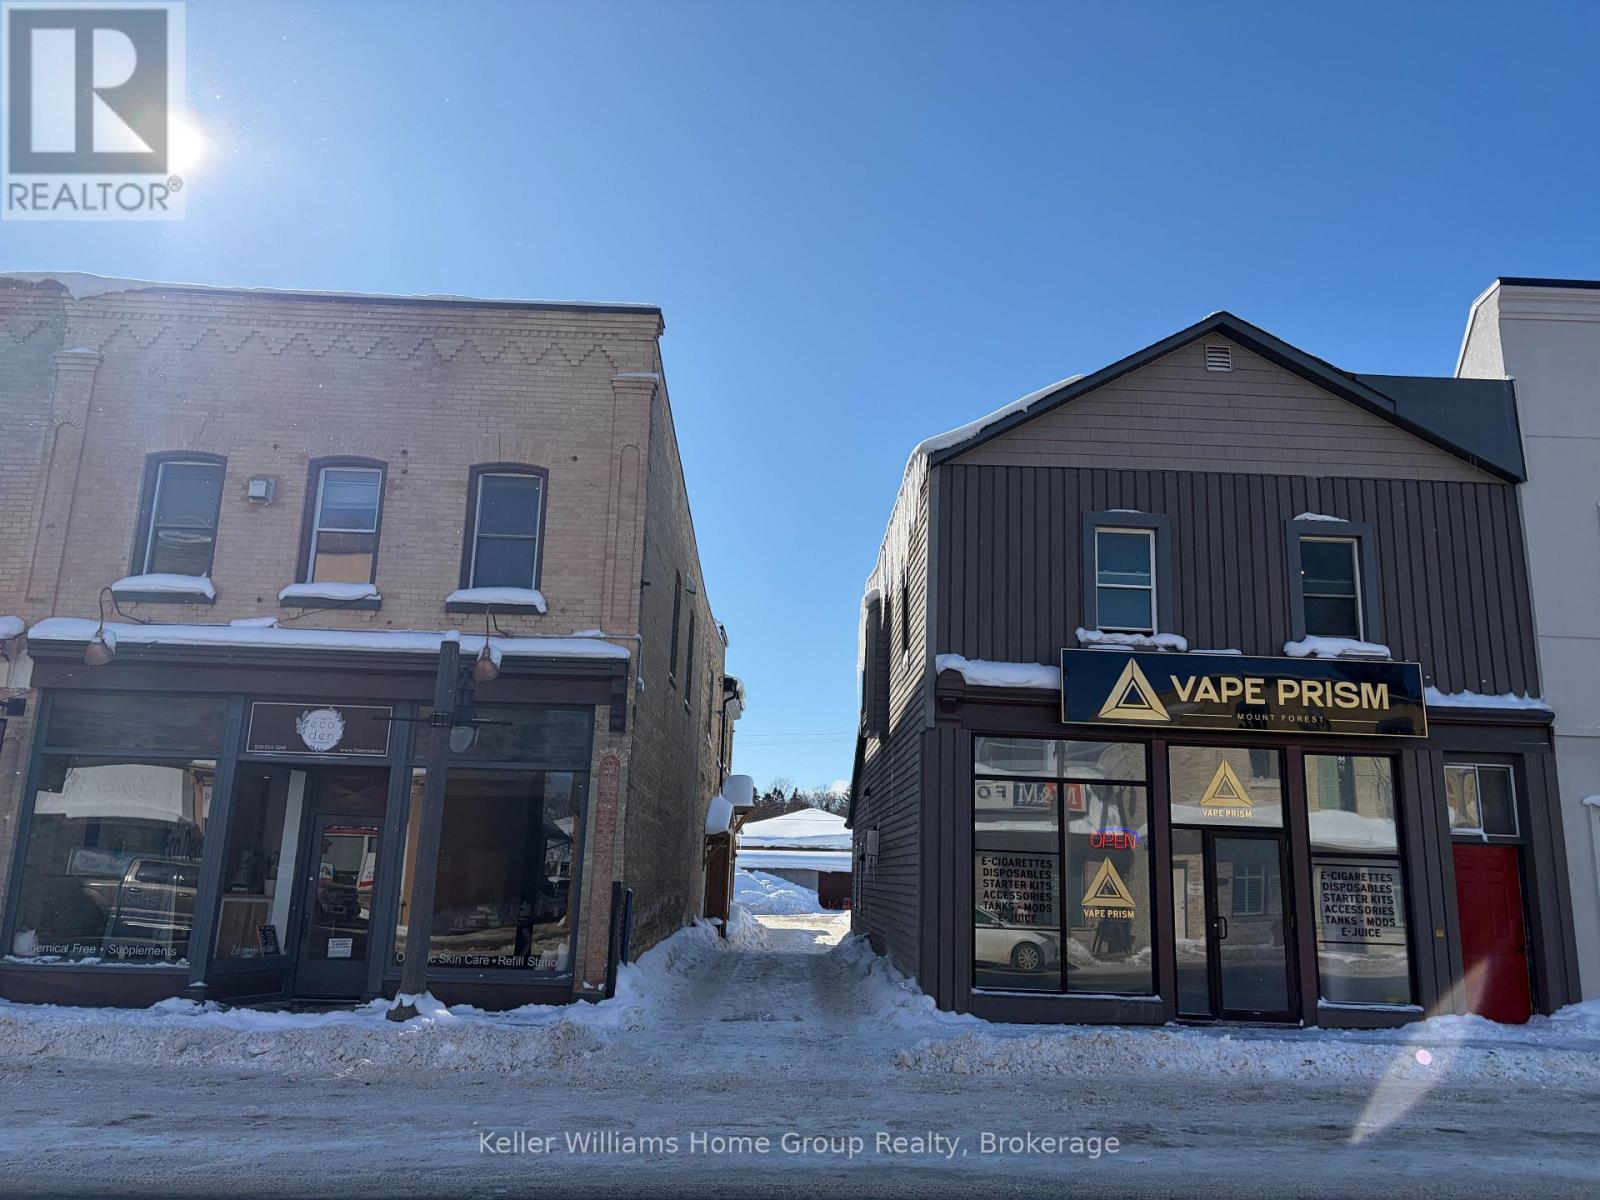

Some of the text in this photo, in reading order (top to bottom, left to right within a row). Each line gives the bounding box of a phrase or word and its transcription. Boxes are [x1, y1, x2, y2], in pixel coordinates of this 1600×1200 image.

[1169, 675, 1390, 710] VAPE PRISM
[310, 720, 335, 729] eco
[1237, 713, 1325, 724] MOUNT FOREST
[308, 730, 334, 740] den
[1202, 808, 1252, 818] VAPE PRISM
[1089, 831, 1136, 850] OPEN
[981, 856, 1053, 869] E-CIGARETTES
[983, 868, 1051, 879] DISPOSABLES
[1320, 871, 1393, 883] E-CIGARETTES
[982, 879, 1052, 890] STARTER KITS
[1322, 882, 1393, 894] DISPOSABLES
[983, 890, 1052, 901] ACCESSORIES
[1323, 893, 1394, 905] STARTER KITS
[982, 901, 1015, 911] TANKS
[1025, 903, 1053, 913] MODS
[1324, 904, 1395, 916] ACCESSORIES
[998, 912, 1038, 924] E-JUICE
[1083, 908, 1135, 919] VAPE PRISM
[1325, 915, 1357, 926] TANKS
[1366, 917, 1396, 927] MODS
[1341, 927, 1381, 938] E-JUICE
[28, 941, 177, 957] hemical Free Supplements
[438, 953, 462, 965] Skin
[464, 954, 490, 966] Care
[498, 955, 524, 967] Refill
[527, 957, 560, 968] Statio
